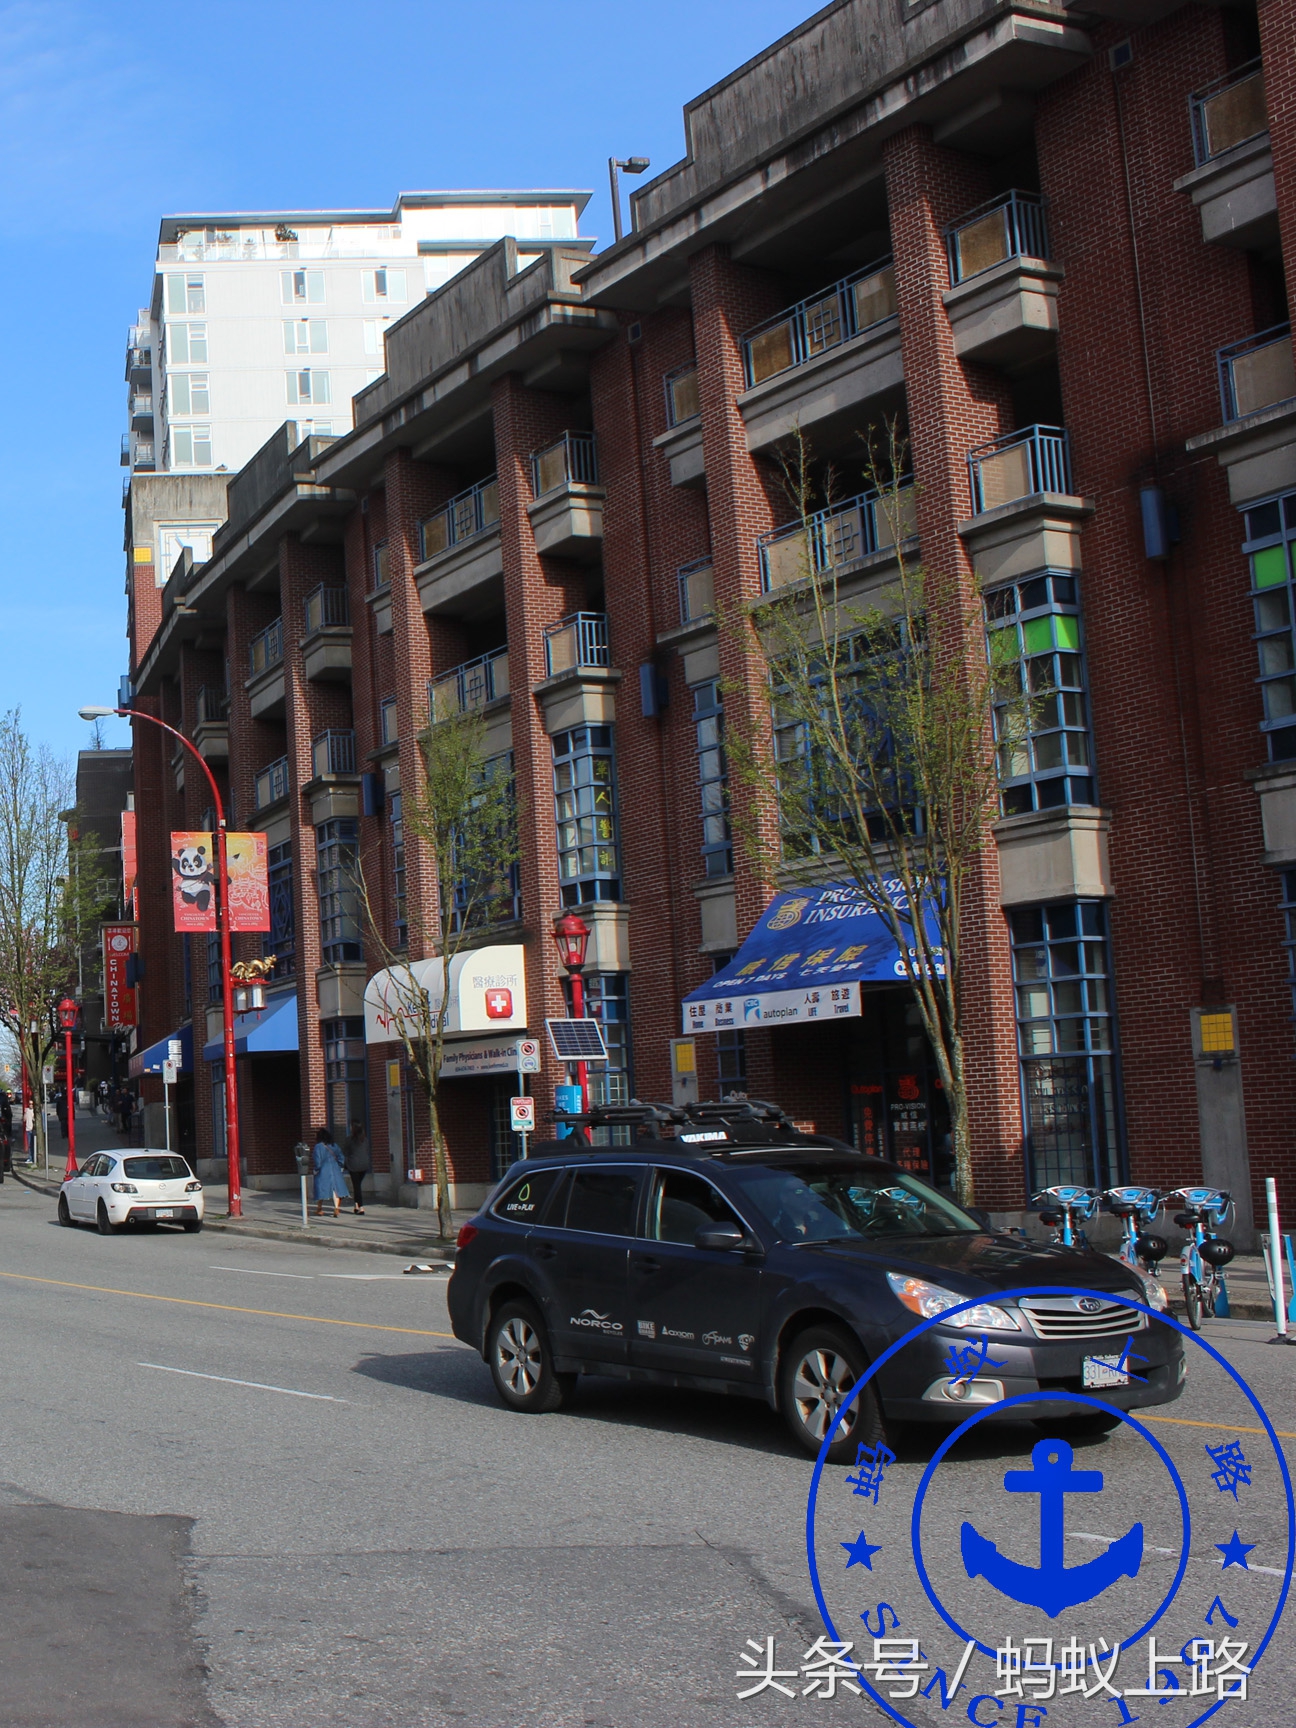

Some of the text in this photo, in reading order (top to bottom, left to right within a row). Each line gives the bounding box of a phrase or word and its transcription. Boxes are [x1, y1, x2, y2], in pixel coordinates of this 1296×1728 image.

[473, 973, 518, 988] 醫療診所
[713, 978, 745, 989] OPEN
[753, 972, 789, 983] DAYS
[110, 959, 121, 1022] CHINATOWN
[763, 1006, 798, 1019] autoplan
[834, 1003, 849, 1014] Travel
[443, 1053, 458, 1064] Family
[459, 1051, 483, 1063] Physicians
[488, 1048, 506, 1058] Walk-in
[890, 1102, 926, 1111] PRO-VISION
[680, 1131, 728, 1143] YAKIMA
[506, 1203, 519, 1211] LIVE
[521, 1203, 536, 1211] PLAY
[570, 1317, 624, 1331] NORCO
